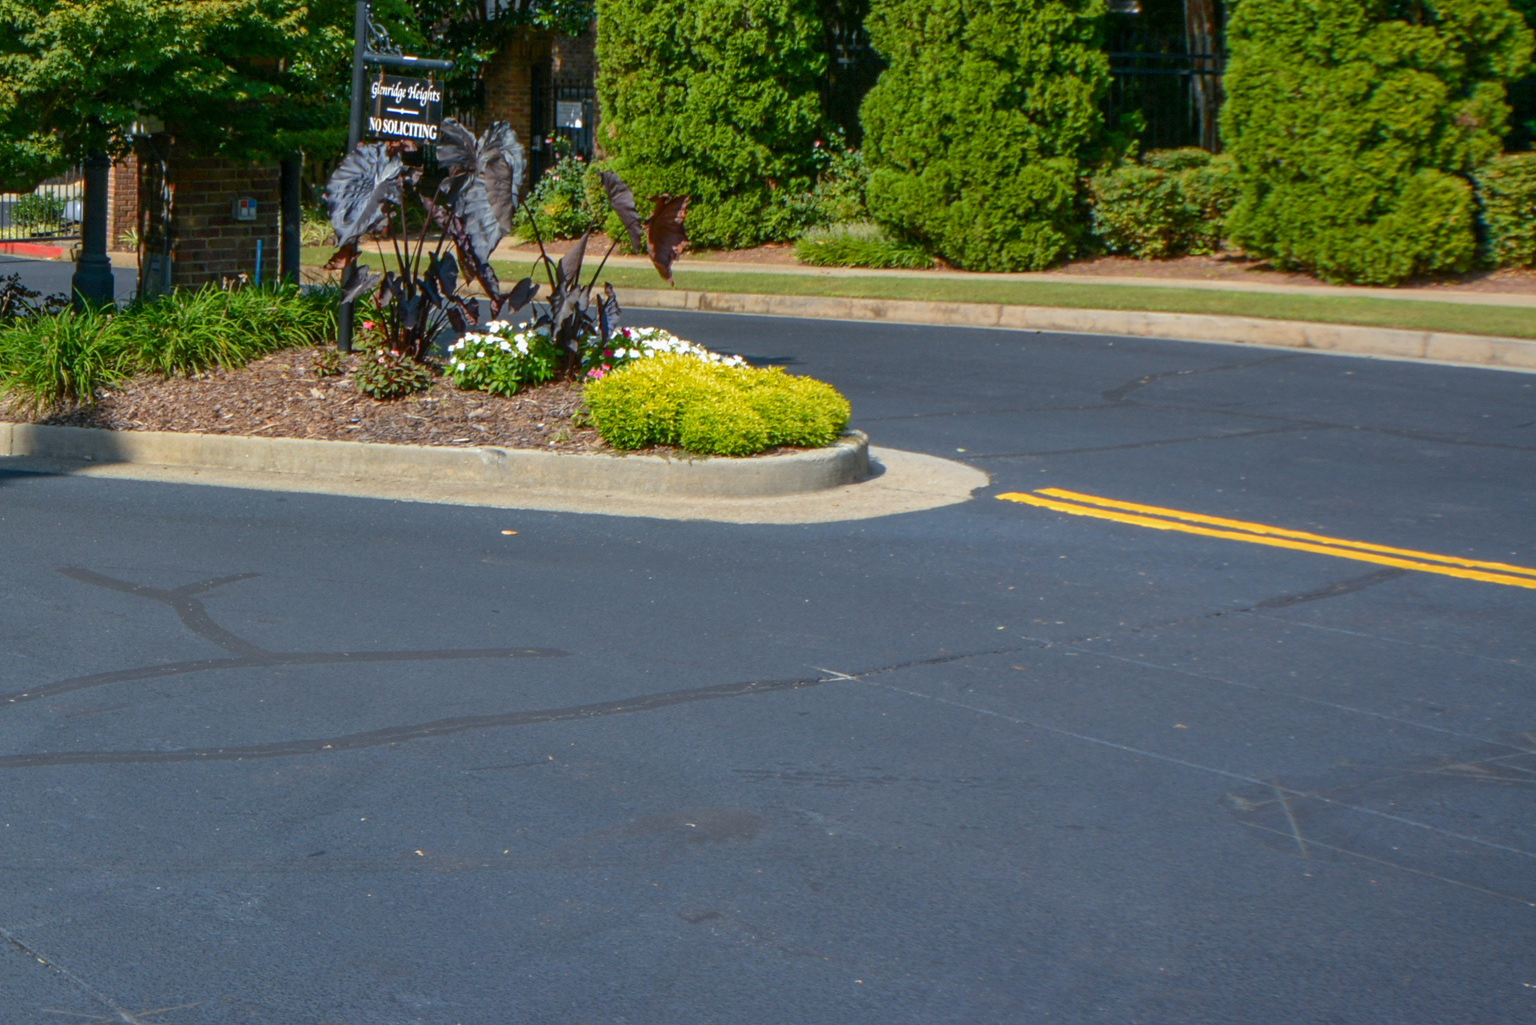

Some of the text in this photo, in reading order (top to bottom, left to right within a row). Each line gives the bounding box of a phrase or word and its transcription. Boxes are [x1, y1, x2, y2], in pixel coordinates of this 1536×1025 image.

[371, 81, 441, 107] Glenridge Heights
[369, 117, 438, 140] NO SOLICITING
